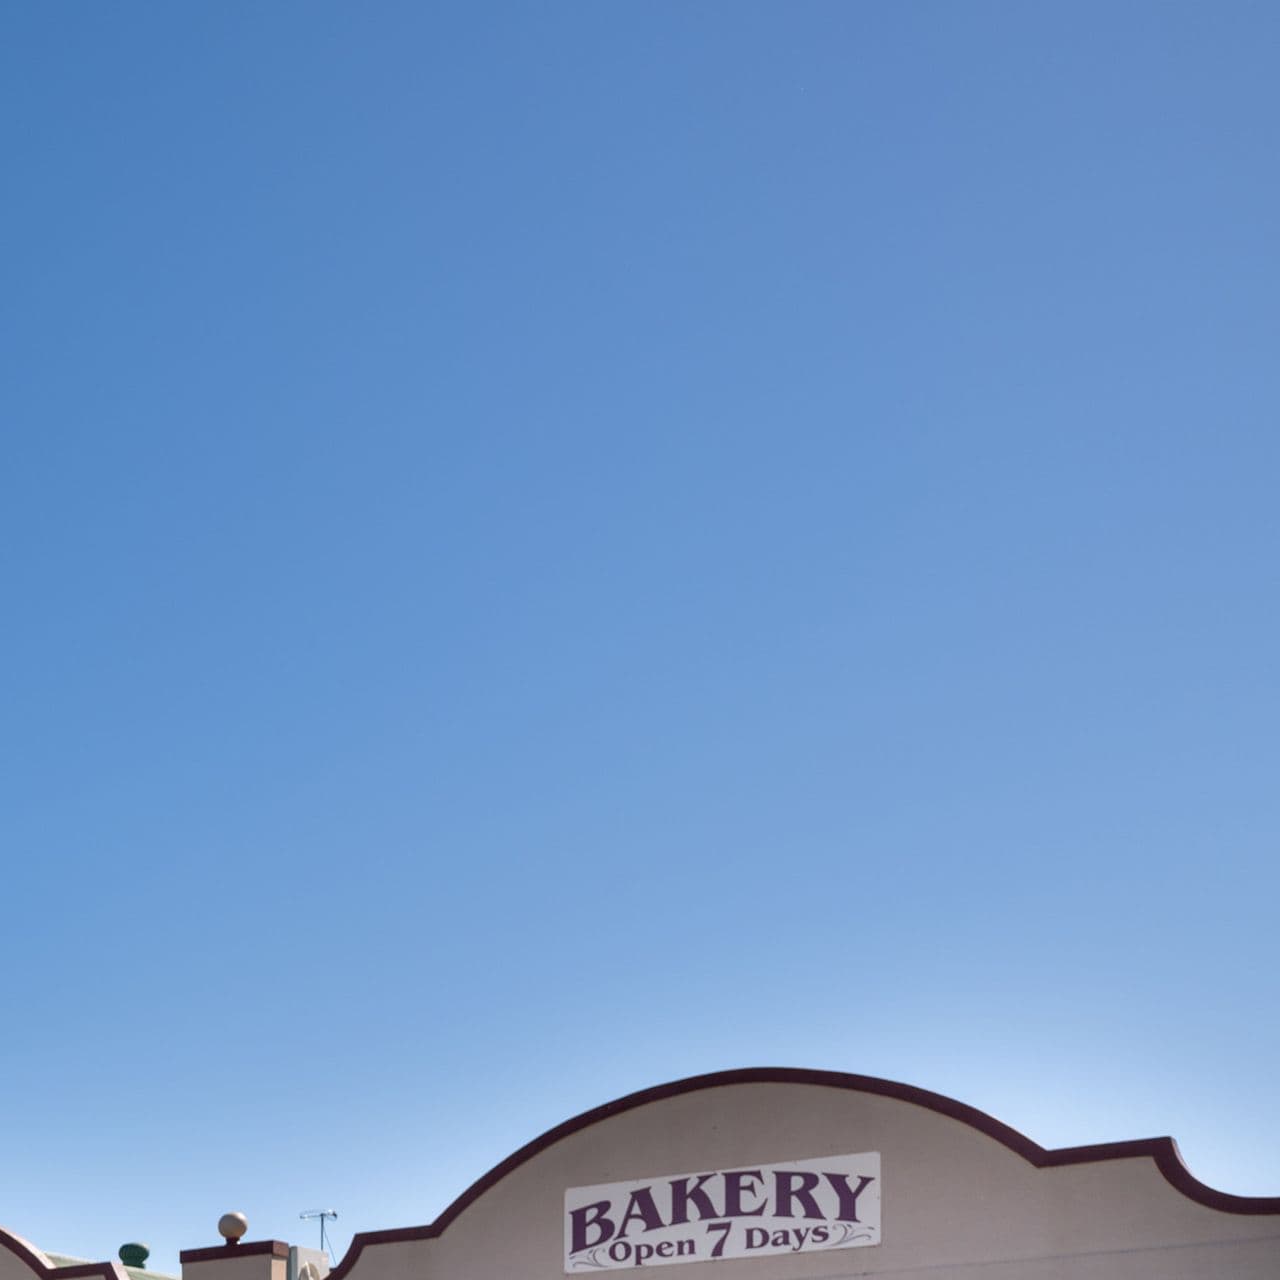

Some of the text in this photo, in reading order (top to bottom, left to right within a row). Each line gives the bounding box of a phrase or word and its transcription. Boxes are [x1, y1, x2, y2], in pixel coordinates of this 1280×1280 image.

[568, 1169, 876, 1257] BAKERY
[608, 1221, 830, 1266] Open 7 Days
